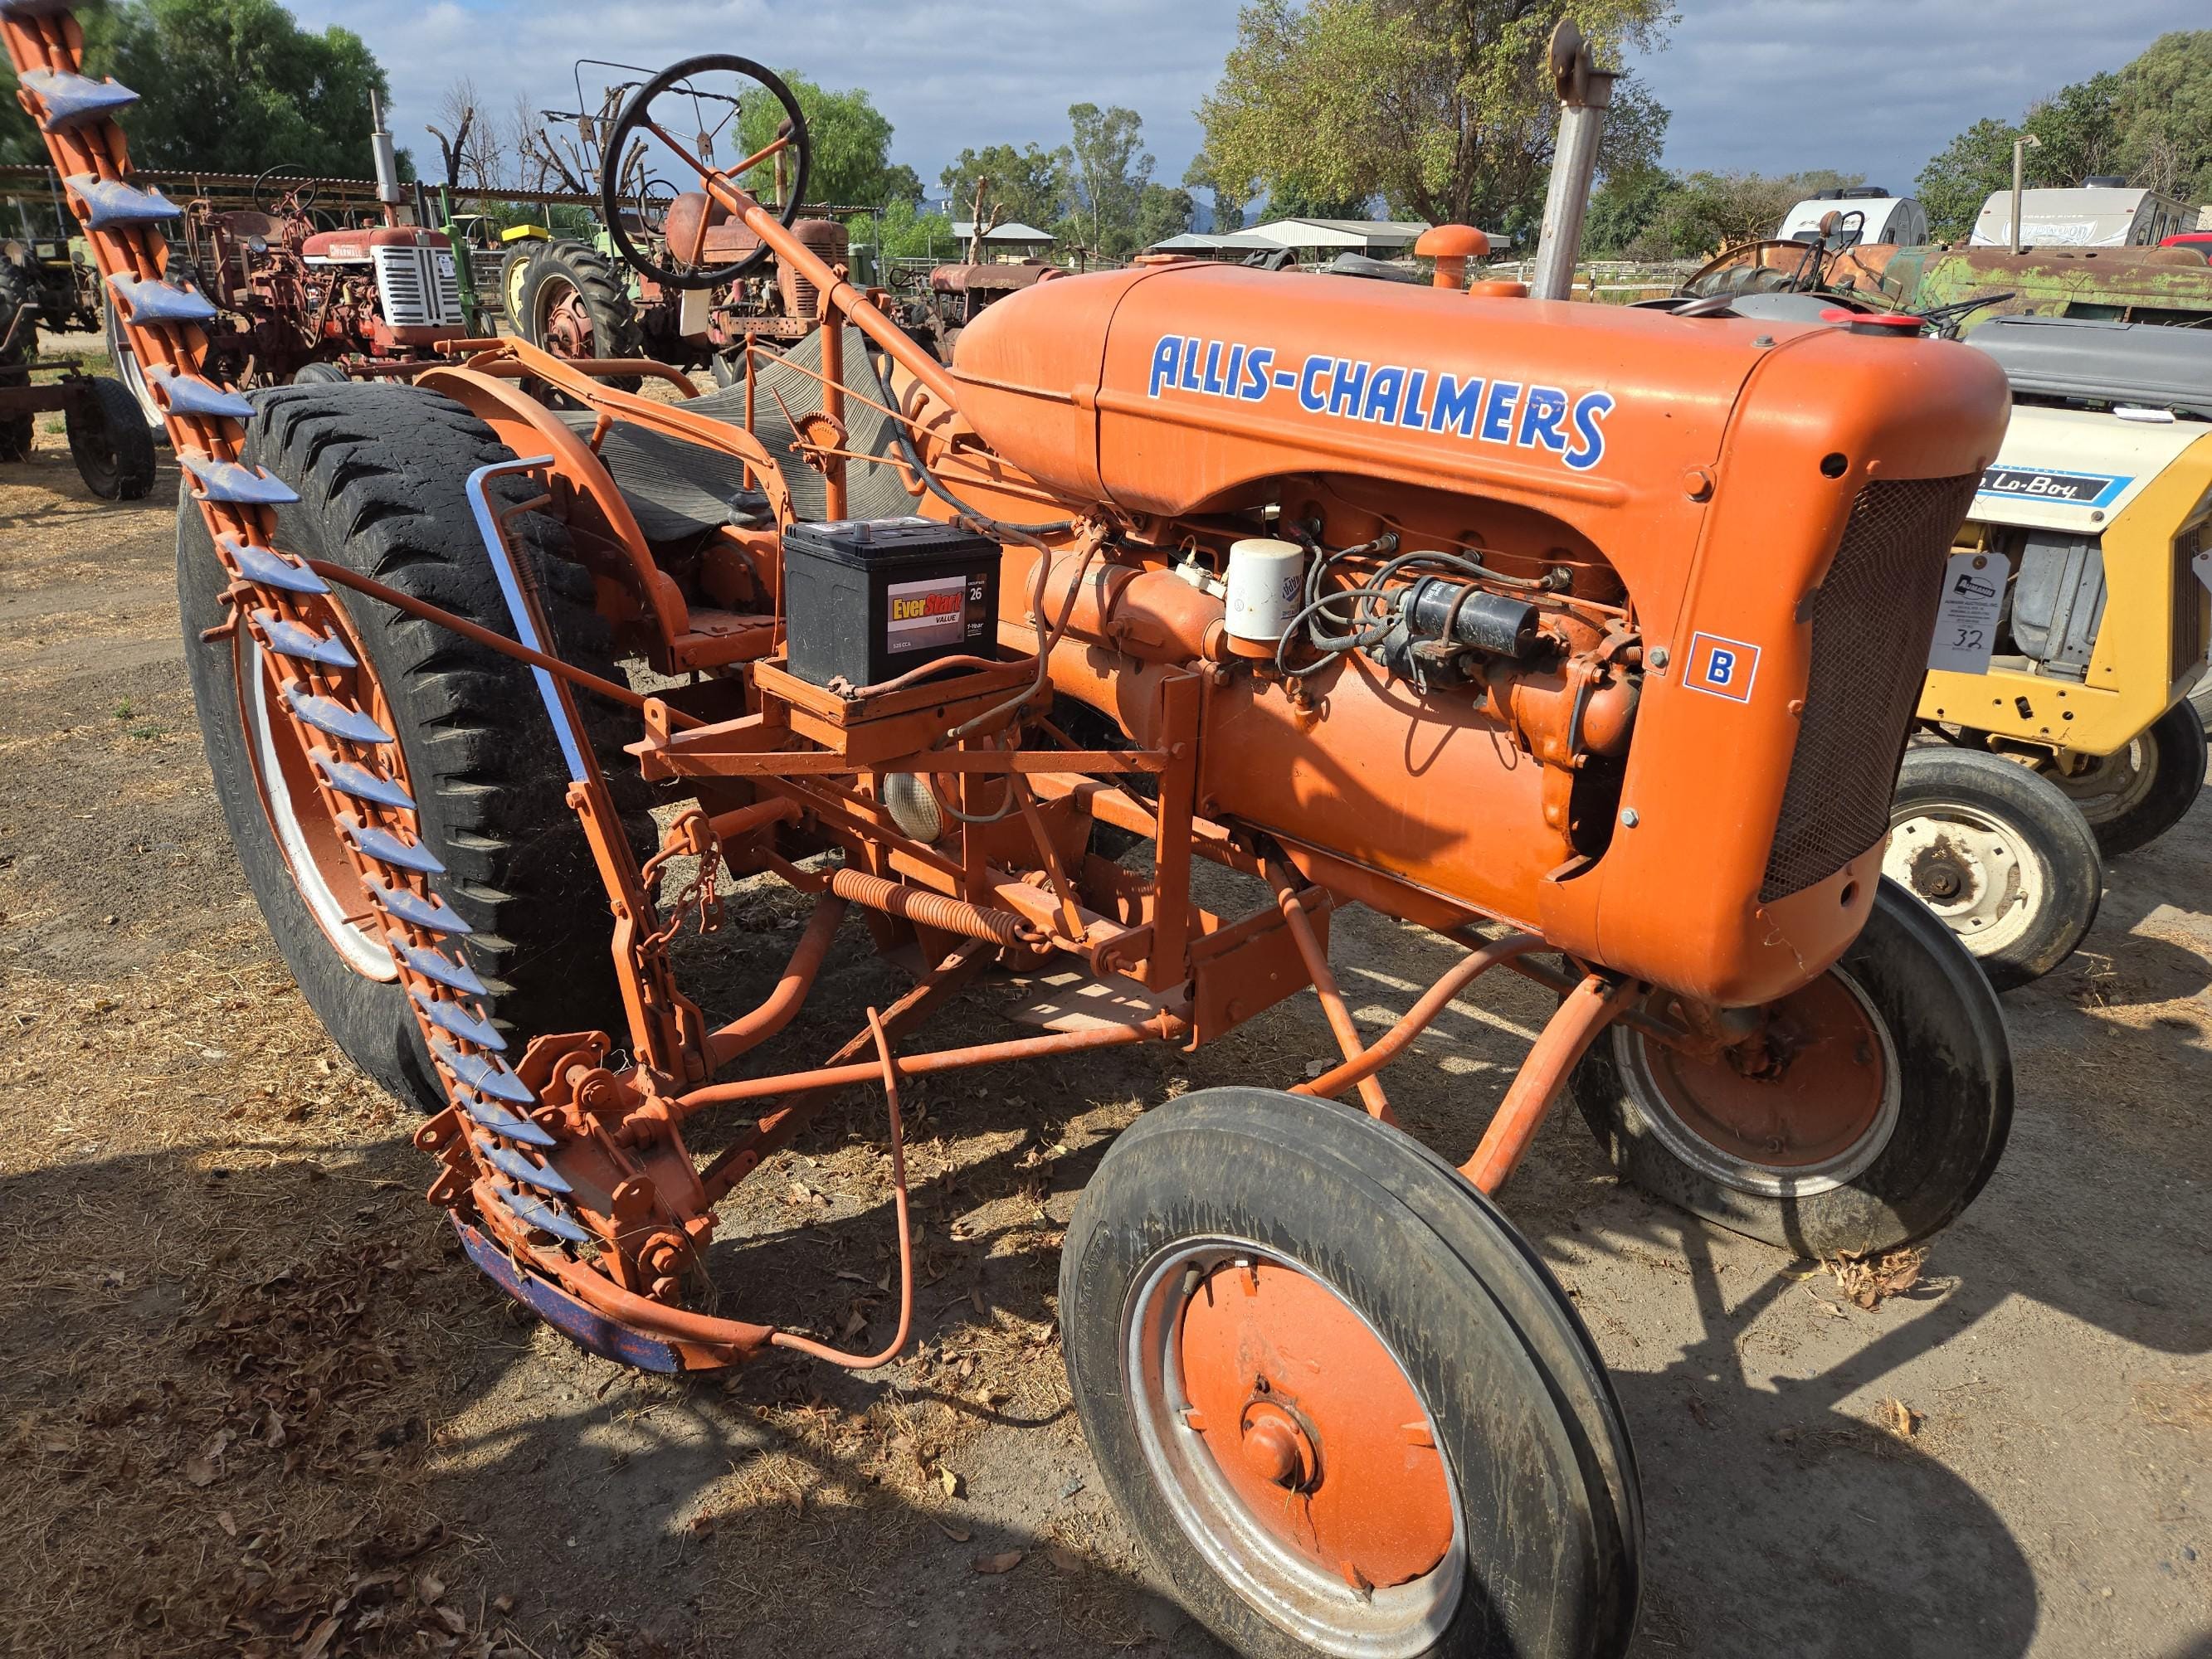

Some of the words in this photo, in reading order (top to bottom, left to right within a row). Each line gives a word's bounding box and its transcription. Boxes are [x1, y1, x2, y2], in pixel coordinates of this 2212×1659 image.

[1147, 333, 1615, 471] ALLIS-CHALMERS
[970, 586, 982, 601] 26
[894, 592, 962, 620] EverStart
[936, 615, 957, 624] VALUE
[1952, 629, 1983, 649] 32
[1706, 647, 1737, 687] B
